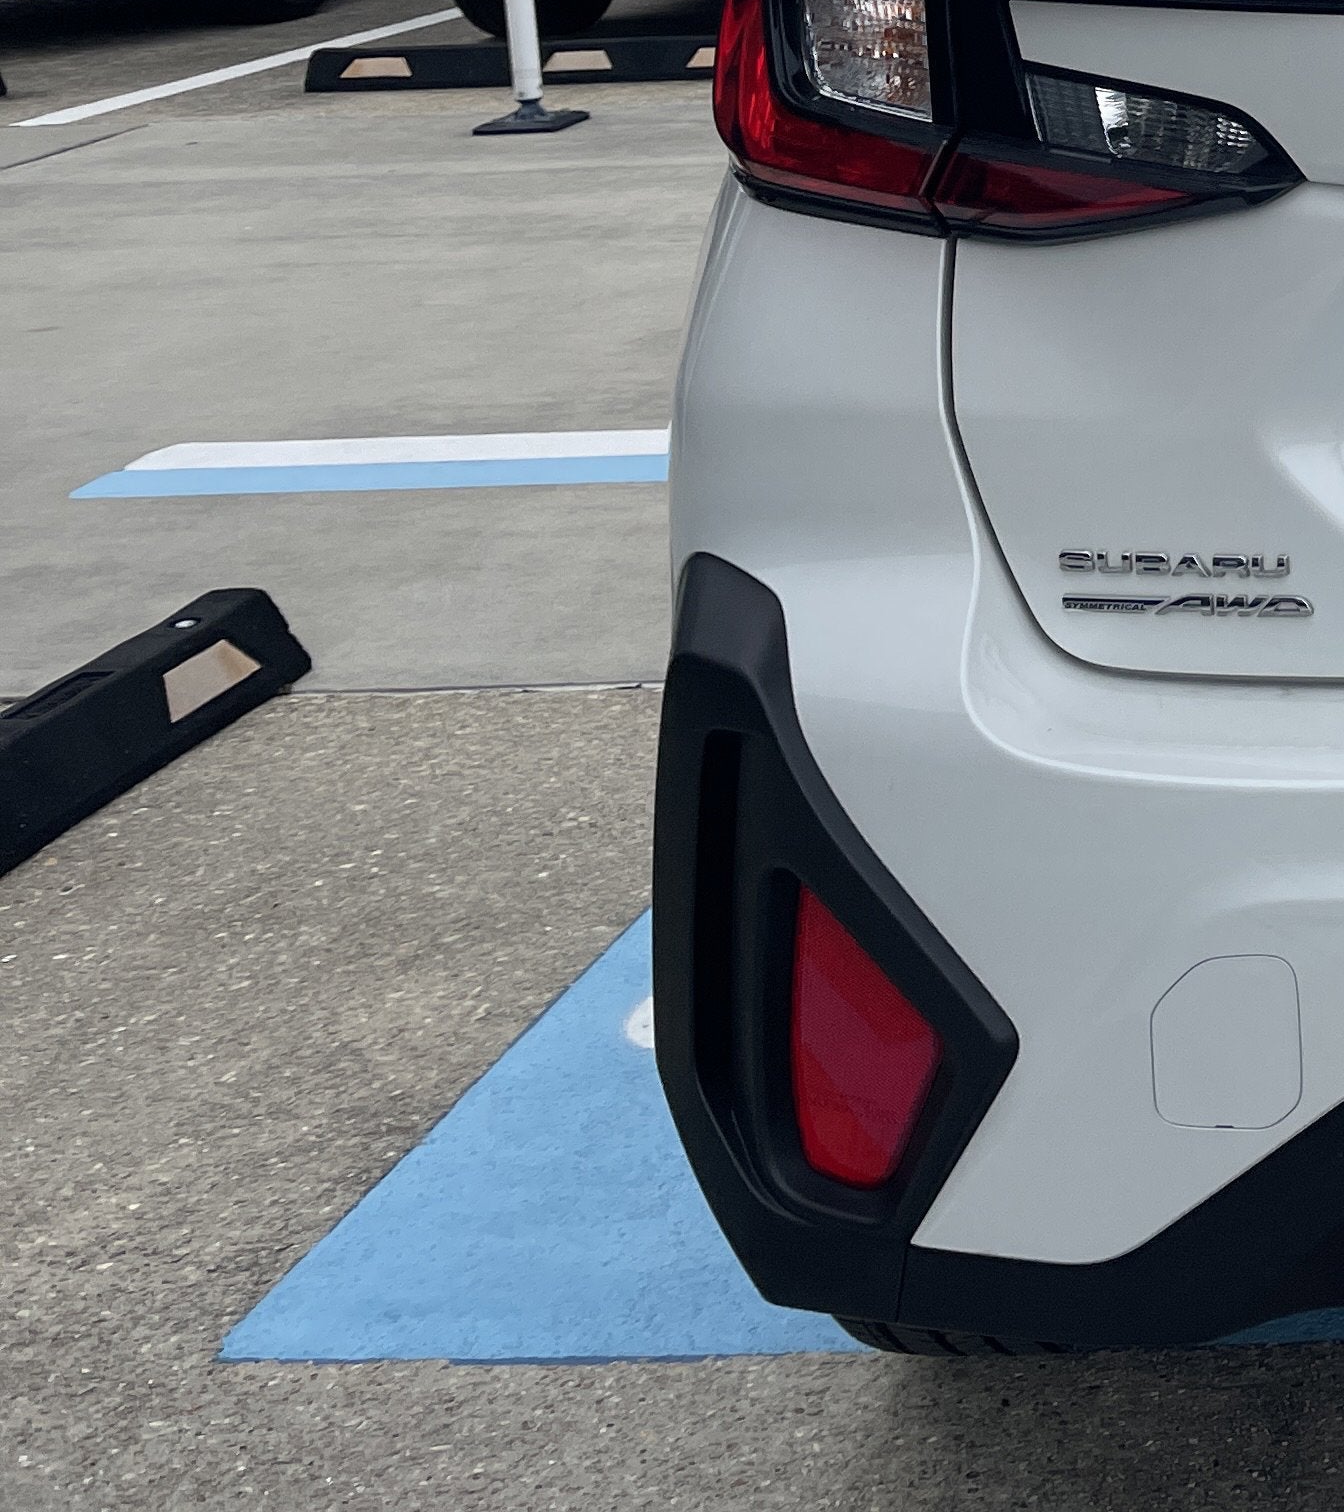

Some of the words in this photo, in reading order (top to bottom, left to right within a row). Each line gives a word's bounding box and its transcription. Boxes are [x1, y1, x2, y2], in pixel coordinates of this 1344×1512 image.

[1058, 549, 1291, 579] SUBARU
[1063, 600, 1148, 612] SYMMETRICAL
[1154, 592, 1315, 618] AWD
